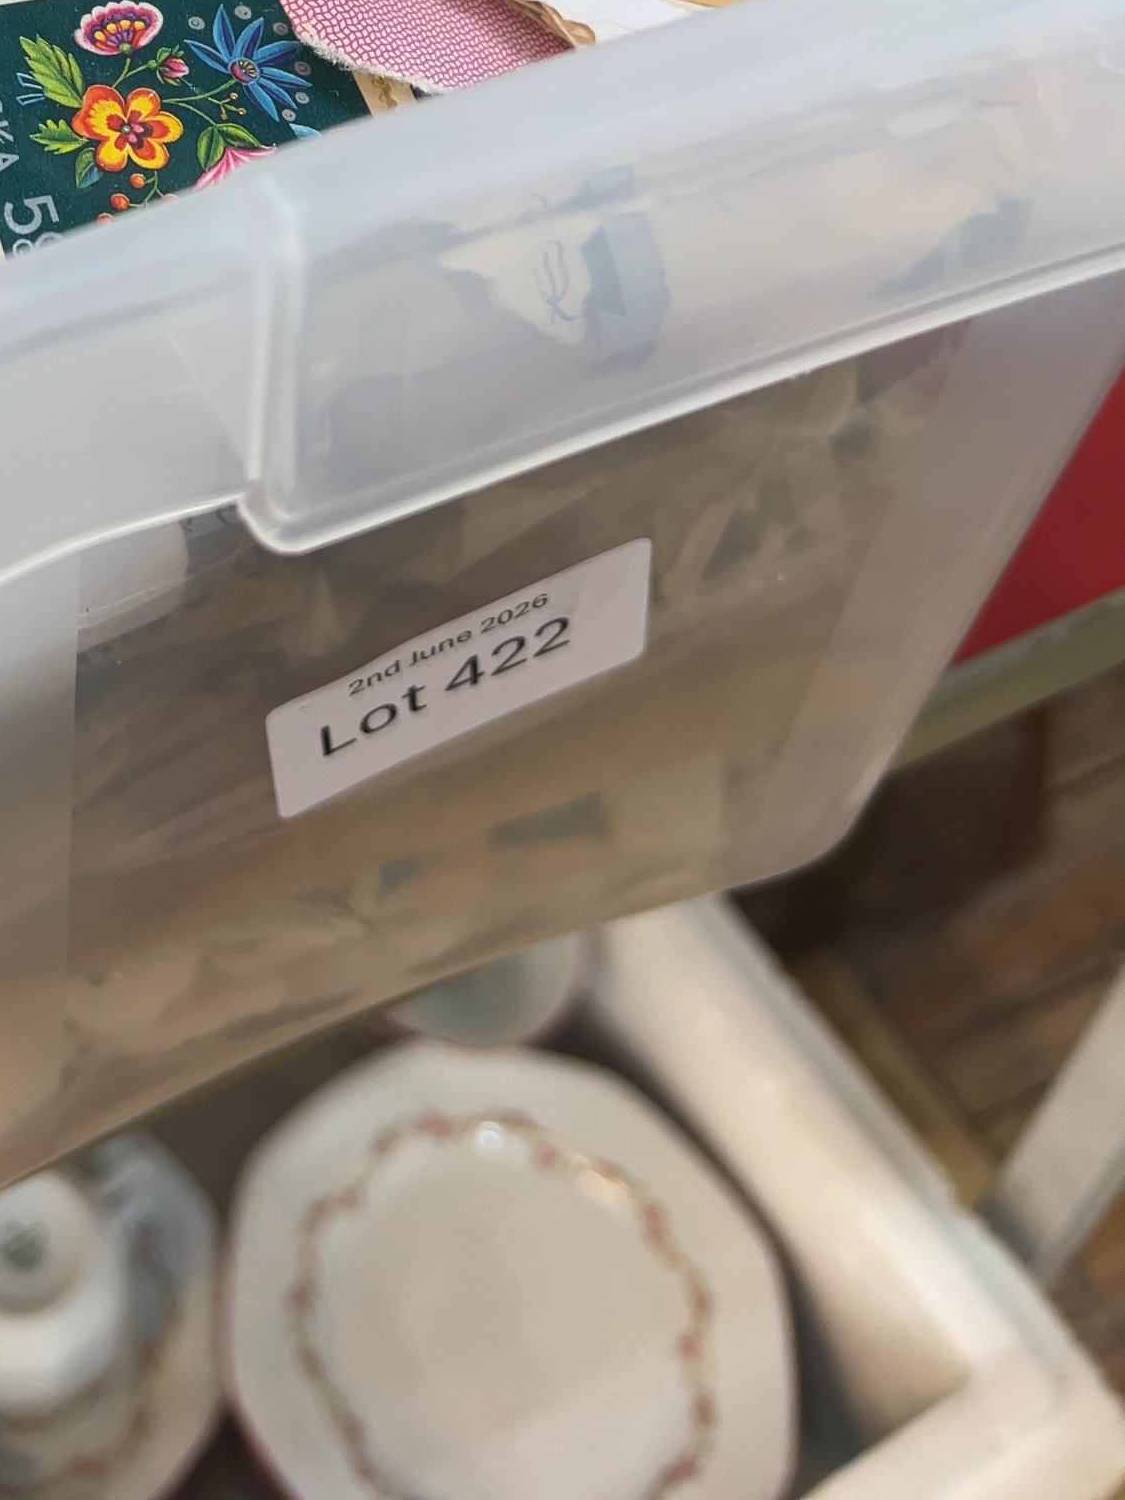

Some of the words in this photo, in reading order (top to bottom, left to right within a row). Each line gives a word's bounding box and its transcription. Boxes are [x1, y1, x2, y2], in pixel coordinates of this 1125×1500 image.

[319, 683, 428, 758] Lot
[443, 615, 573, 693] 422
[348, 658, 401, 698] 2nd
[407, 630, 474, 668] June
[479, 592, 550, 636] 2026
